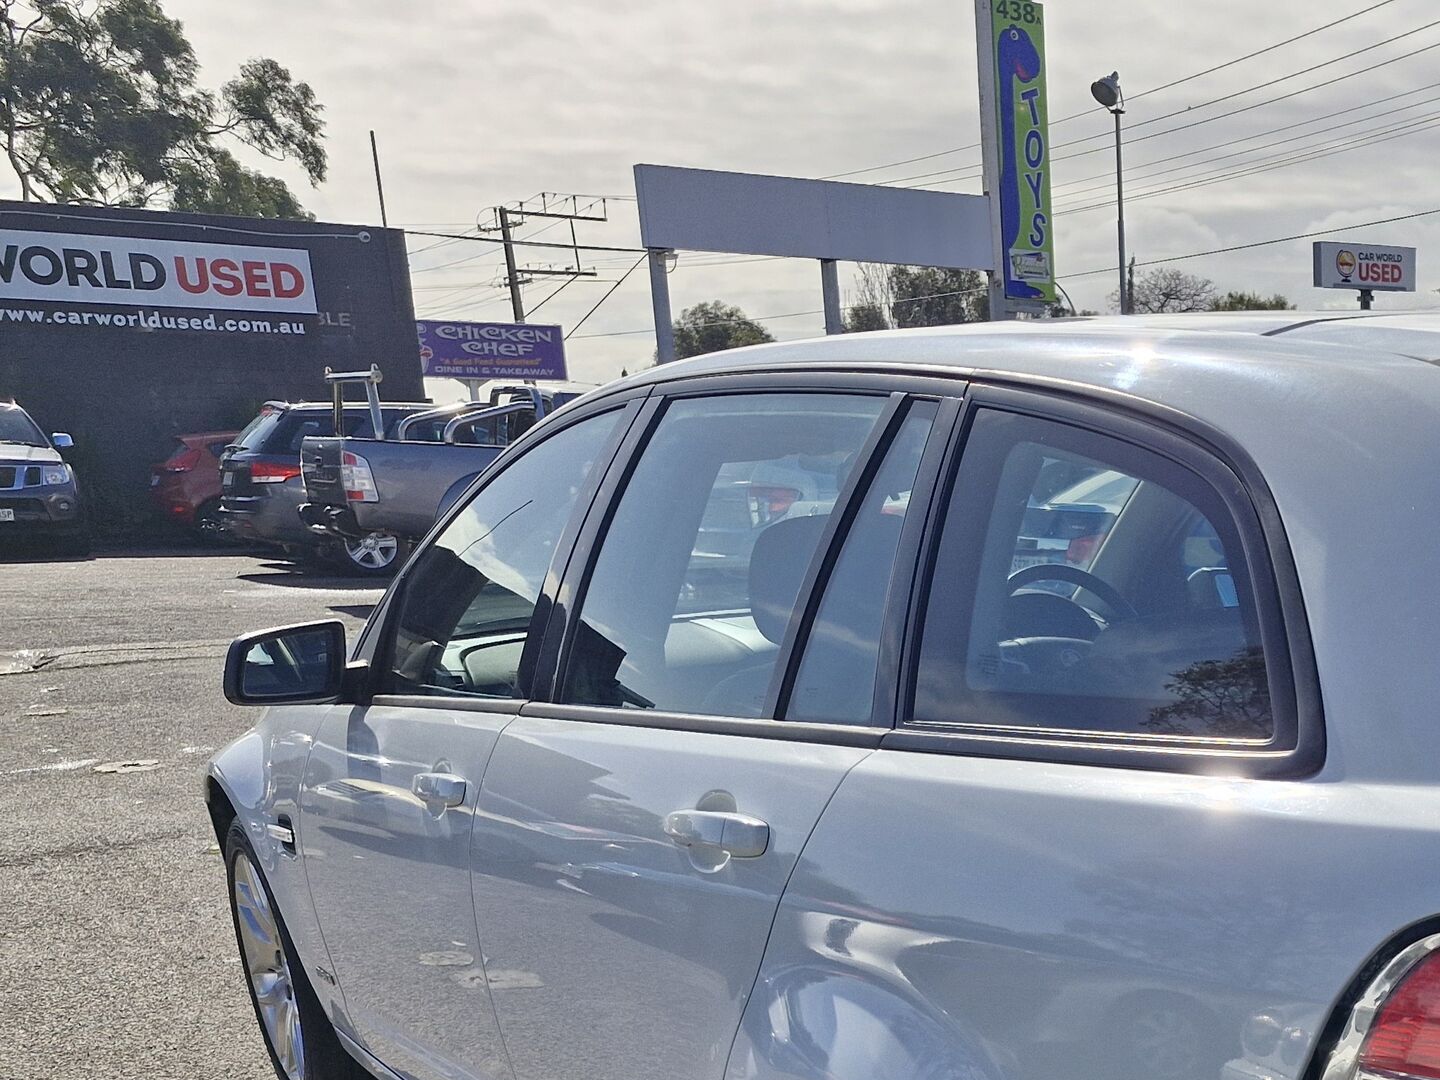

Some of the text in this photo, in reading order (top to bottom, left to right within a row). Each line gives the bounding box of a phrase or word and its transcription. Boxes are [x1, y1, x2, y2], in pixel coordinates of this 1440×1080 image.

[1021, 88, 1047, 248] TOYS
[1358, 252, 1403, 263] CAR WORLD
[174, 256, 306, 299] USED
[1358, 263, 1402, 283] USED
[0, 308, 306, 335] ww.carworldused.com.au
[434, 365, 463, 374] DINE
[466, 366, 479, 374] IN
[494, 366, 555, 376] TAKEAWAY
